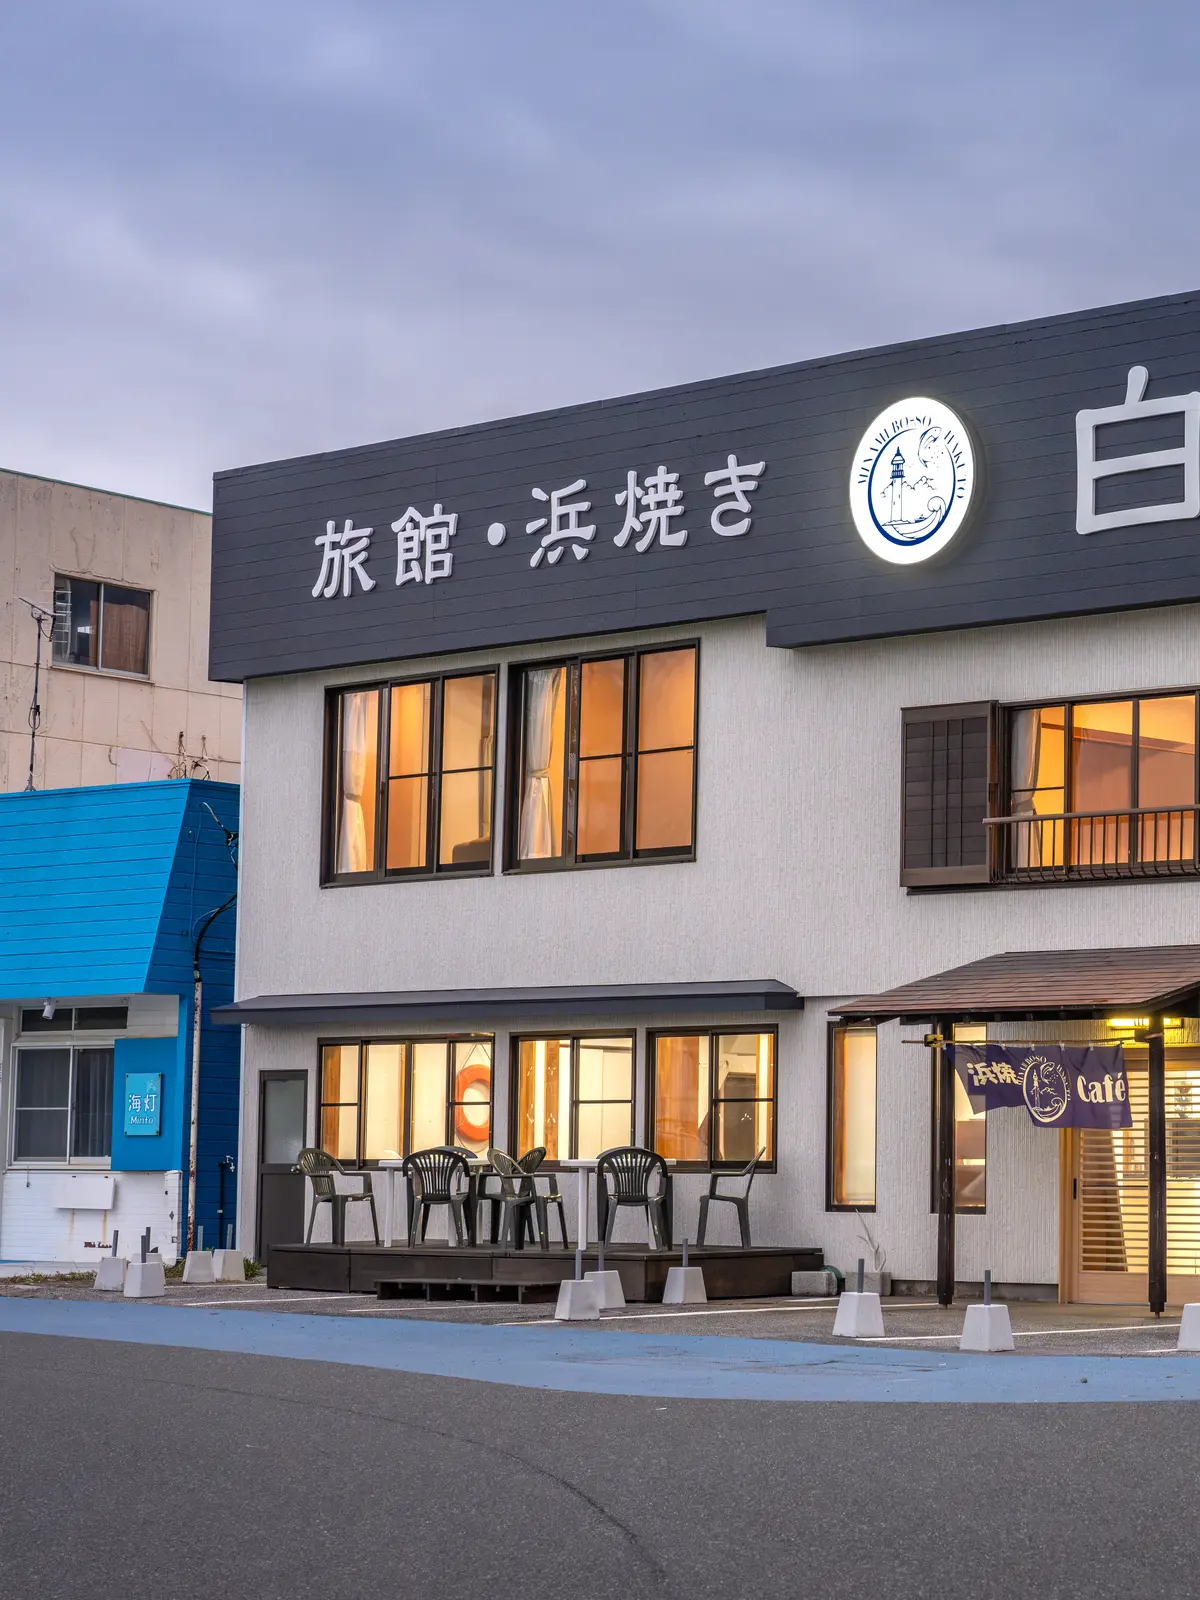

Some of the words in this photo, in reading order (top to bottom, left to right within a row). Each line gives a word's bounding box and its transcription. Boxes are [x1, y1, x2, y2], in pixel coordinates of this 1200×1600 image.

[311, 454, 766, 598] 旅館・浜焼き
[966, 1061, 1019, 1087] 浜焼
[1077, 1072, 1126, 1104] Café
[128, 1093, 157, 1113] 海灯
